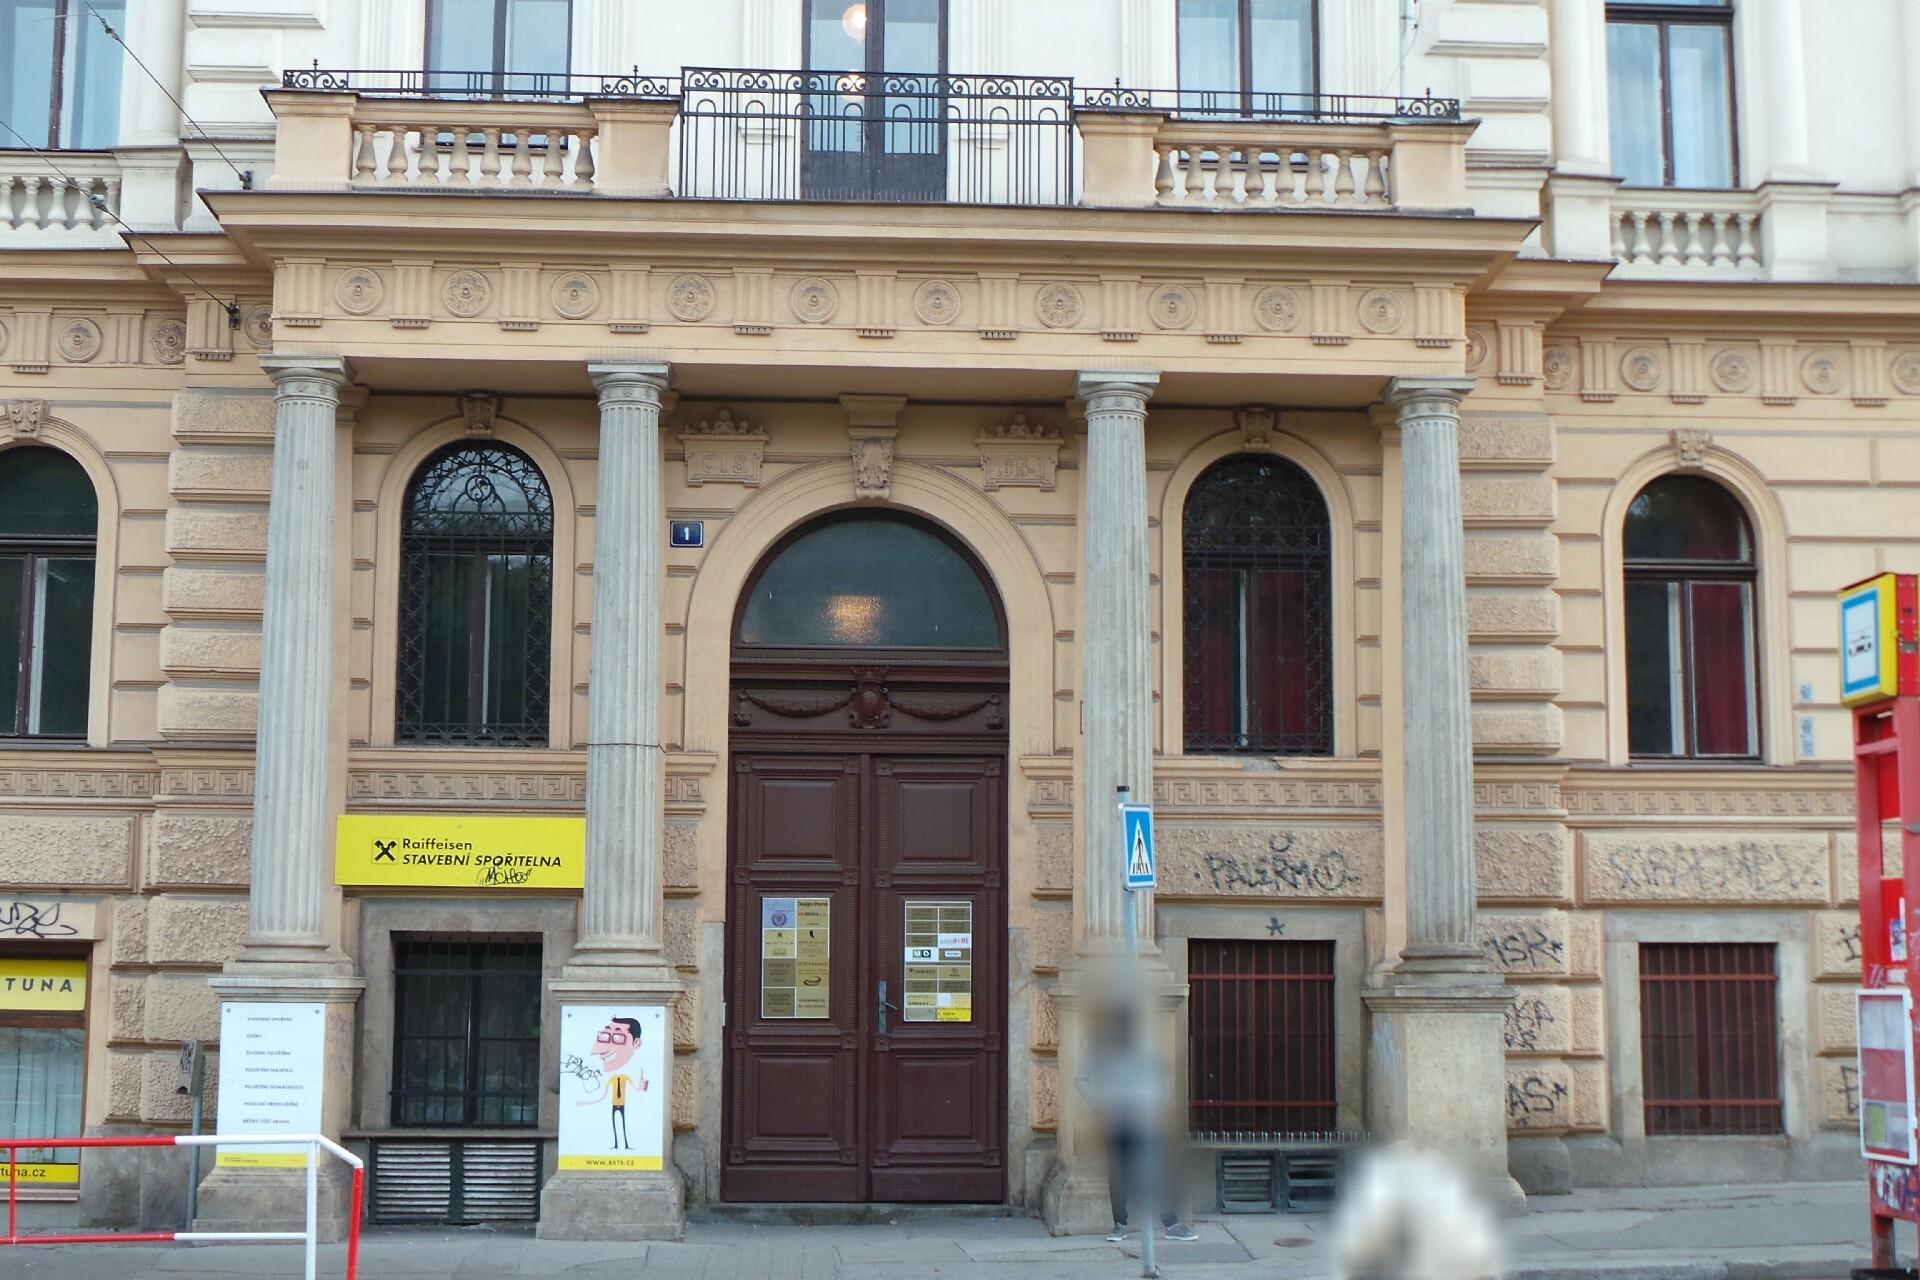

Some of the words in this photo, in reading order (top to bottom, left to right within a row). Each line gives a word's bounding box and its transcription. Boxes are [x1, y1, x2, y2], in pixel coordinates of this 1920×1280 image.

[683, 526, 690, 541] 1
[402, 838, 473, 850] Raiffeisen
[402, 853, 471, 866] STAVEBNÍ
[475, 853, 562, 867] SPOŘITELNA
